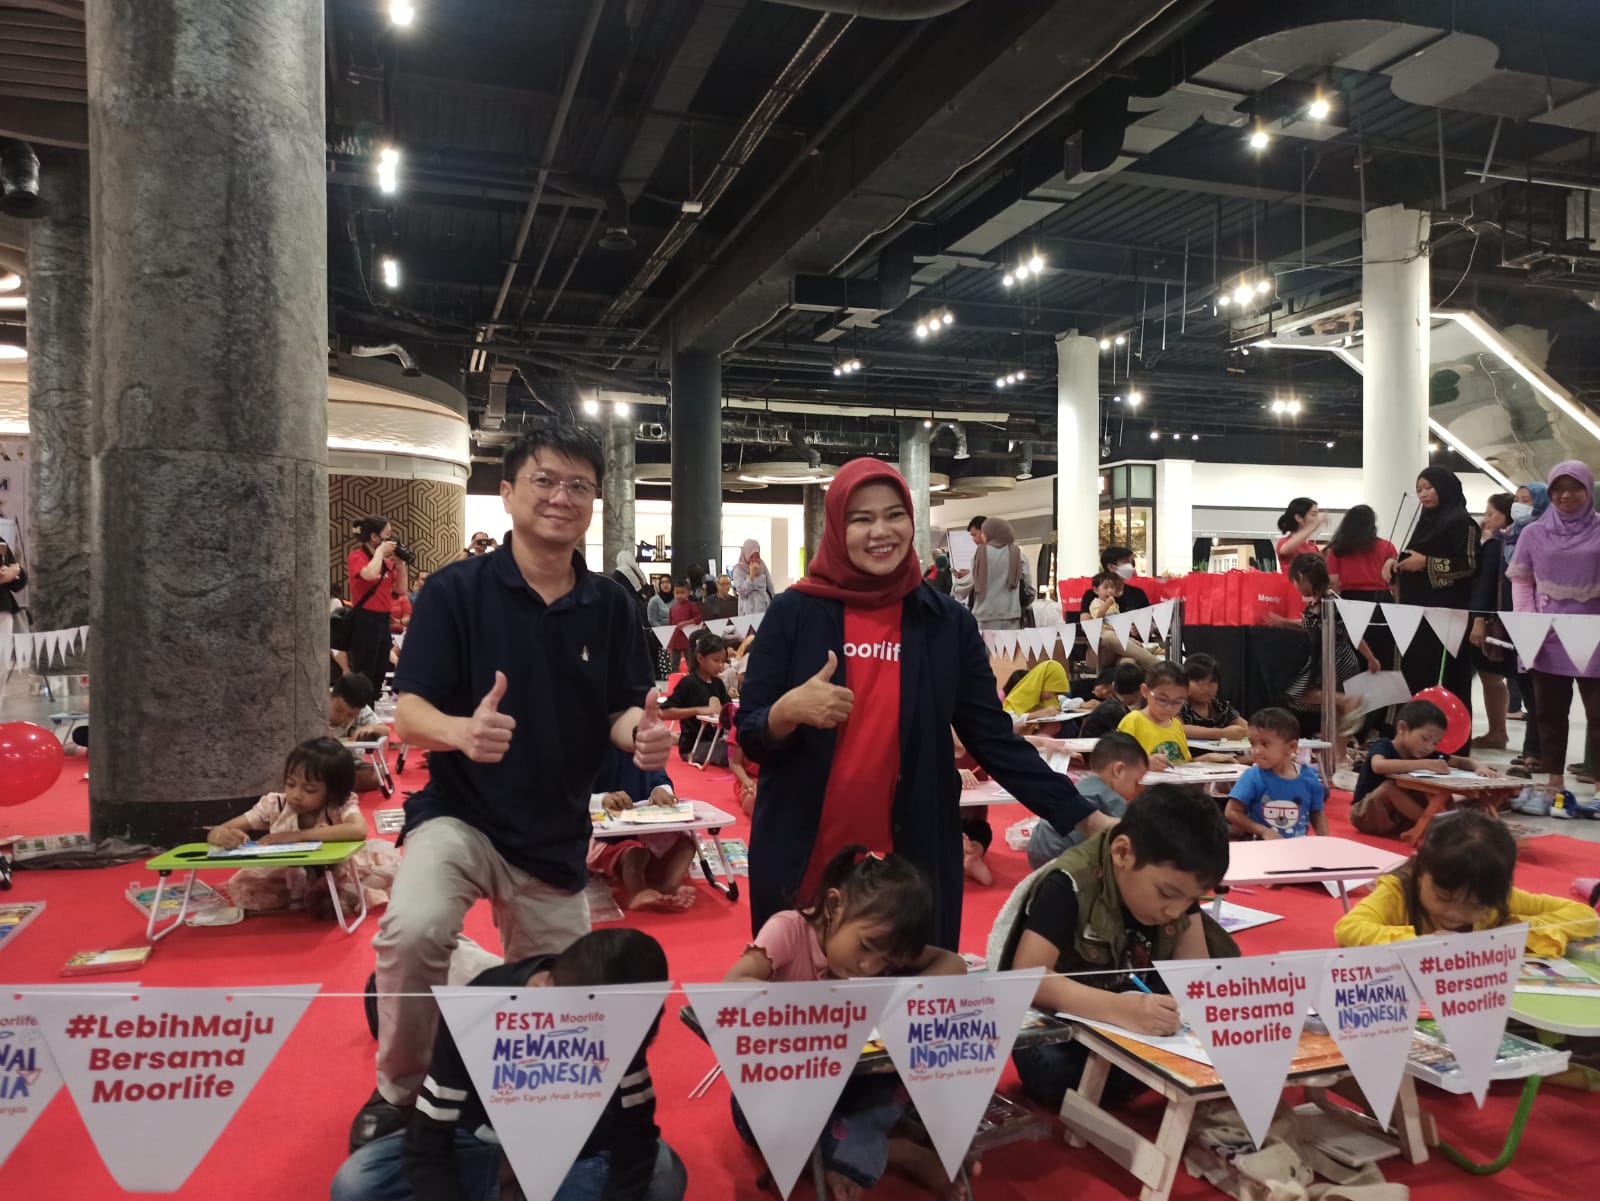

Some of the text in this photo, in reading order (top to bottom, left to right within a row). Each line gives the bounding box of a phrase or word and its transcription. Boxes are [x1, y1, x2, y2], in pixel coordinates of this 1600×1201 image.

[843, 640, 901, 662] oorlif
[1419, 944, 1516, 974] #LebihMaju
[1186, 971, 1306, 999] #LebihMaju
[1331, 966, 1373, 983] PESTA
[1435, 971, 1508, 995] Bersama
[907, 998, 956, 1016] PESTA
[1335, 983, 1407, 1007] MEWARNAI
[1441, 991, 1506, 1017] Moorlife
[495, 1012, 605, 1031] PESTA Moorlife
[716, 1000, 867, 1029] #LebihMaju
[1205, 1002, 1294, 1023] Bersama
[1338, 1005, 1408, 1030] INDONESIA
[65, 1011, 274, 1043] #LebihMaju
[908, 1018, 997, 1043] MEWARNAI
[1211, 1022, 1292, 1047] Moorlife
[492, 1033, 606, 1061] MEWARNAI
[736, 1033, 848, 1055] Bersama
[909, 1042, 996, 1069] INDONESIA
[88, 1047, 245, 1071] Bersama
[741, 1056, 842, 1083] Moorlife
[492, 1062, 603, 1090] INDONESIA
[92, 1075, 234, 1103] Moorlife
